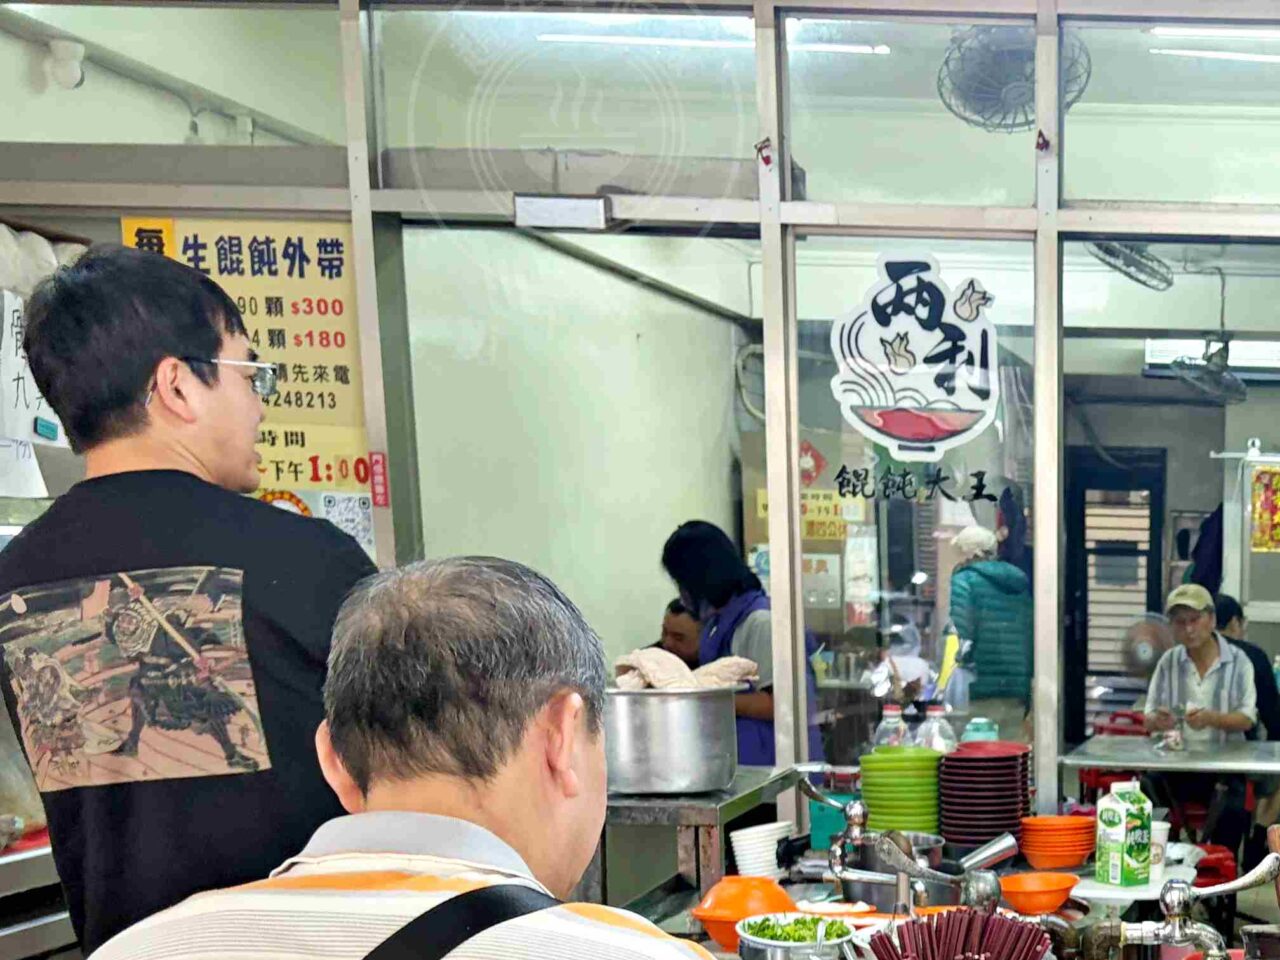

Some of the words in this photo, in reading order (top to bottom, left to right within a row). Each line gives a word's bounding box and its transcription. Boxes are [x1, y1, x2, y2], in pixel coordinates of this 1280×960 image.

[182, 234, 344, 279] 生餛飩外帶
[265, 297, 284, 317] 顆
[291, 298, 343, 316] $300
[268, 328, 286, 349] 顆
[294, 331, 346, 348] $180
[834, 464, 998, 502] 餛飩大王
